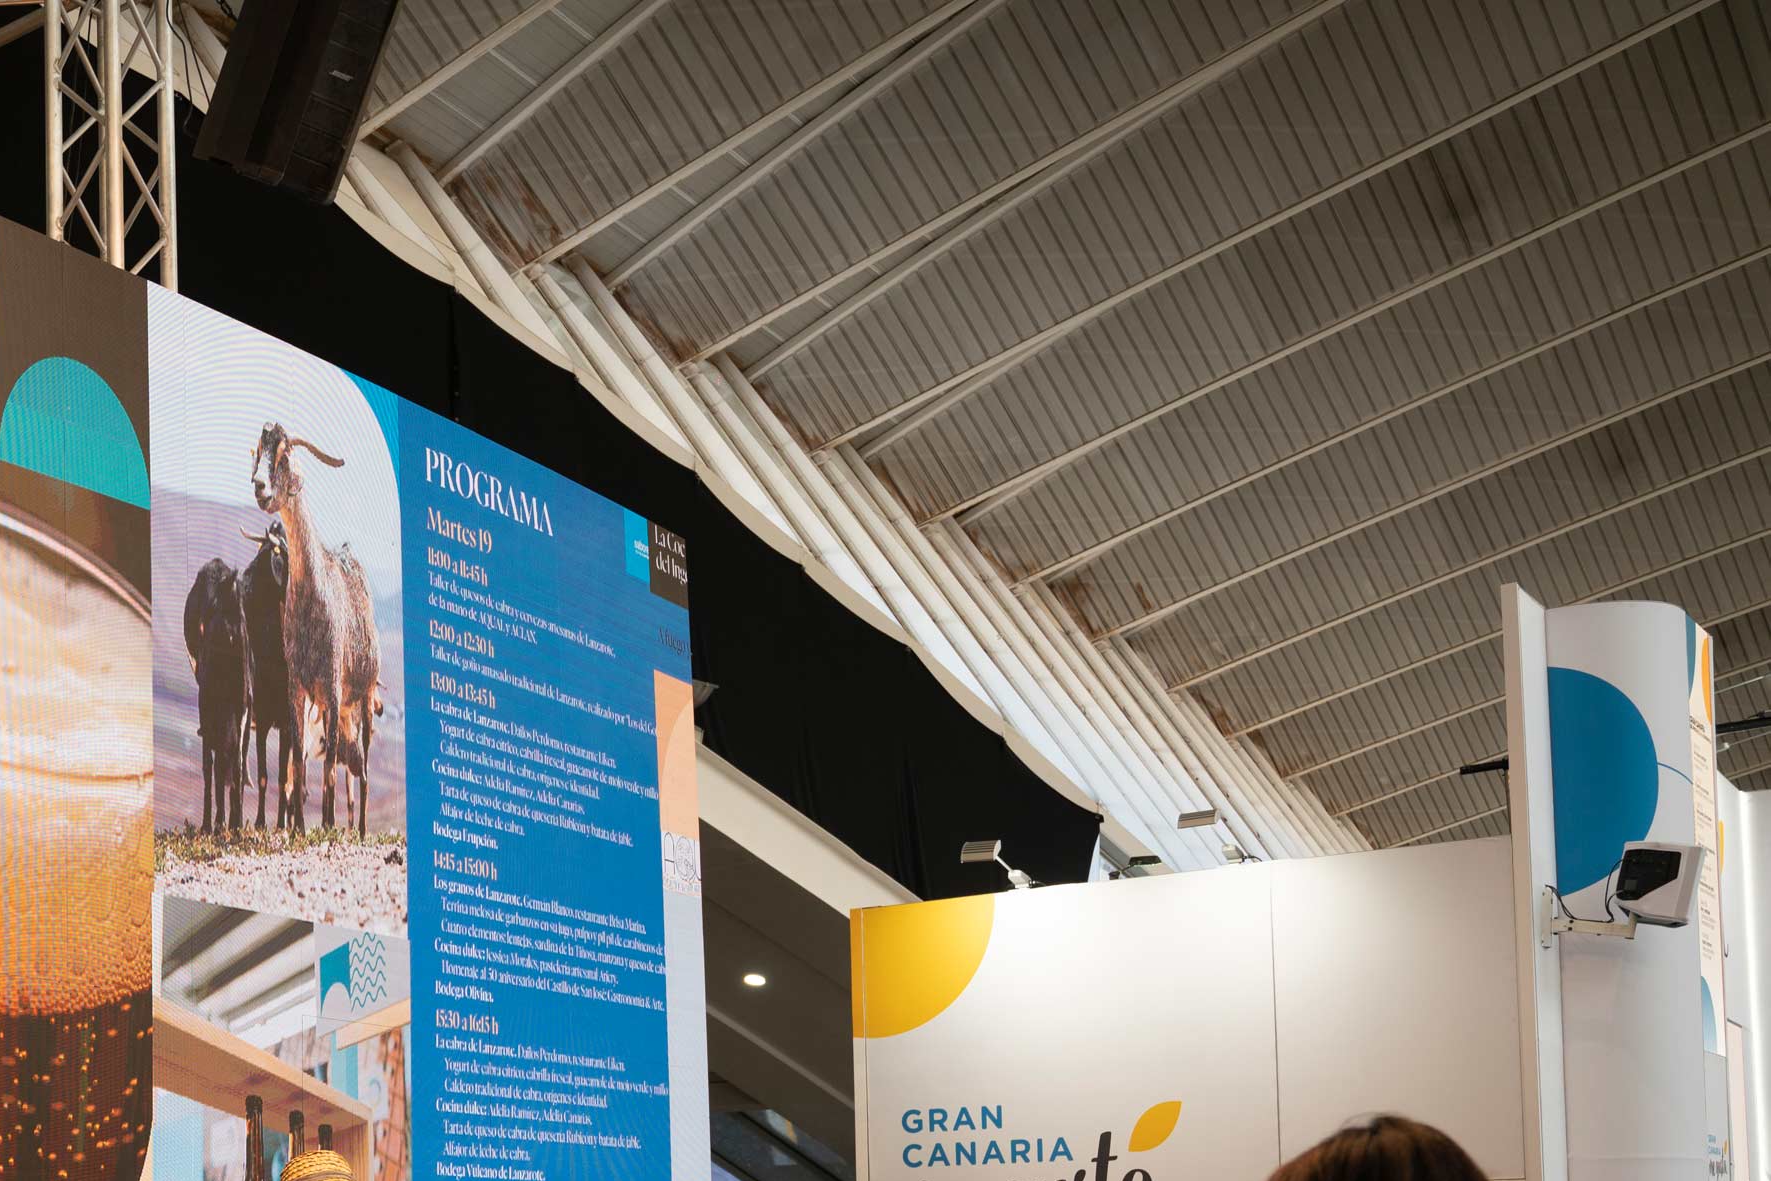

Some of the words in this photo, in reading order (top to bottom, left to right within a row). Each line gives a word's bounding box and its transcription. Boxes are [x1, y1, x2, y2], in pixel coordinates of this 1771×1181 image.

[426, 447, 553, 537] PROGRAMA
[427, 506, 477, 548] Martes
[480, 528, 492, 553] 19
[428, 546, 451, 570] 11:00
[453, 560, 458, 575] a
[460, 559, 480, 582] 11:45
[482, 567, 488, 587] h
[656, 551, 670, 575] del
[430, 619, 455, 643] 12:00
[457, 633, 462, 647] a
[464, 631, 486, 654] 12:30
[489, 639, 494, 658] h
[431, 671, 456, 695] 13:00
[458, 684, 463, 699] a
[465, 682, 487, 706] 13:45
[489, 689, 495, 709] h
[434, 849, 454, 871] 14:15
[456, 859, 462, 873] a
[464, 856, 489, 878] 15:00
[492, 861, 497, 881] h
[435, 979, 464, 1000] Bodega
[466, 985, 494, 1003] Olivina.
[436, 1009, 460, 1028] 15:30
[462, 1016, 467, 1031] a
[469, 1014, 490, 1033] 16:15
[492, 1016, 498, 1035] h
[901, 1105, 1003, 1134] GRAN
[903, 1137, 1073, 1168] CANARIA
[437, 1161, 465, 1181] Bodega
[467, 1163, 497, 1179] Vulcano
[499, 1165, 507, 1180] de
[509, 1165, 546, 1181] Lanzarote.
